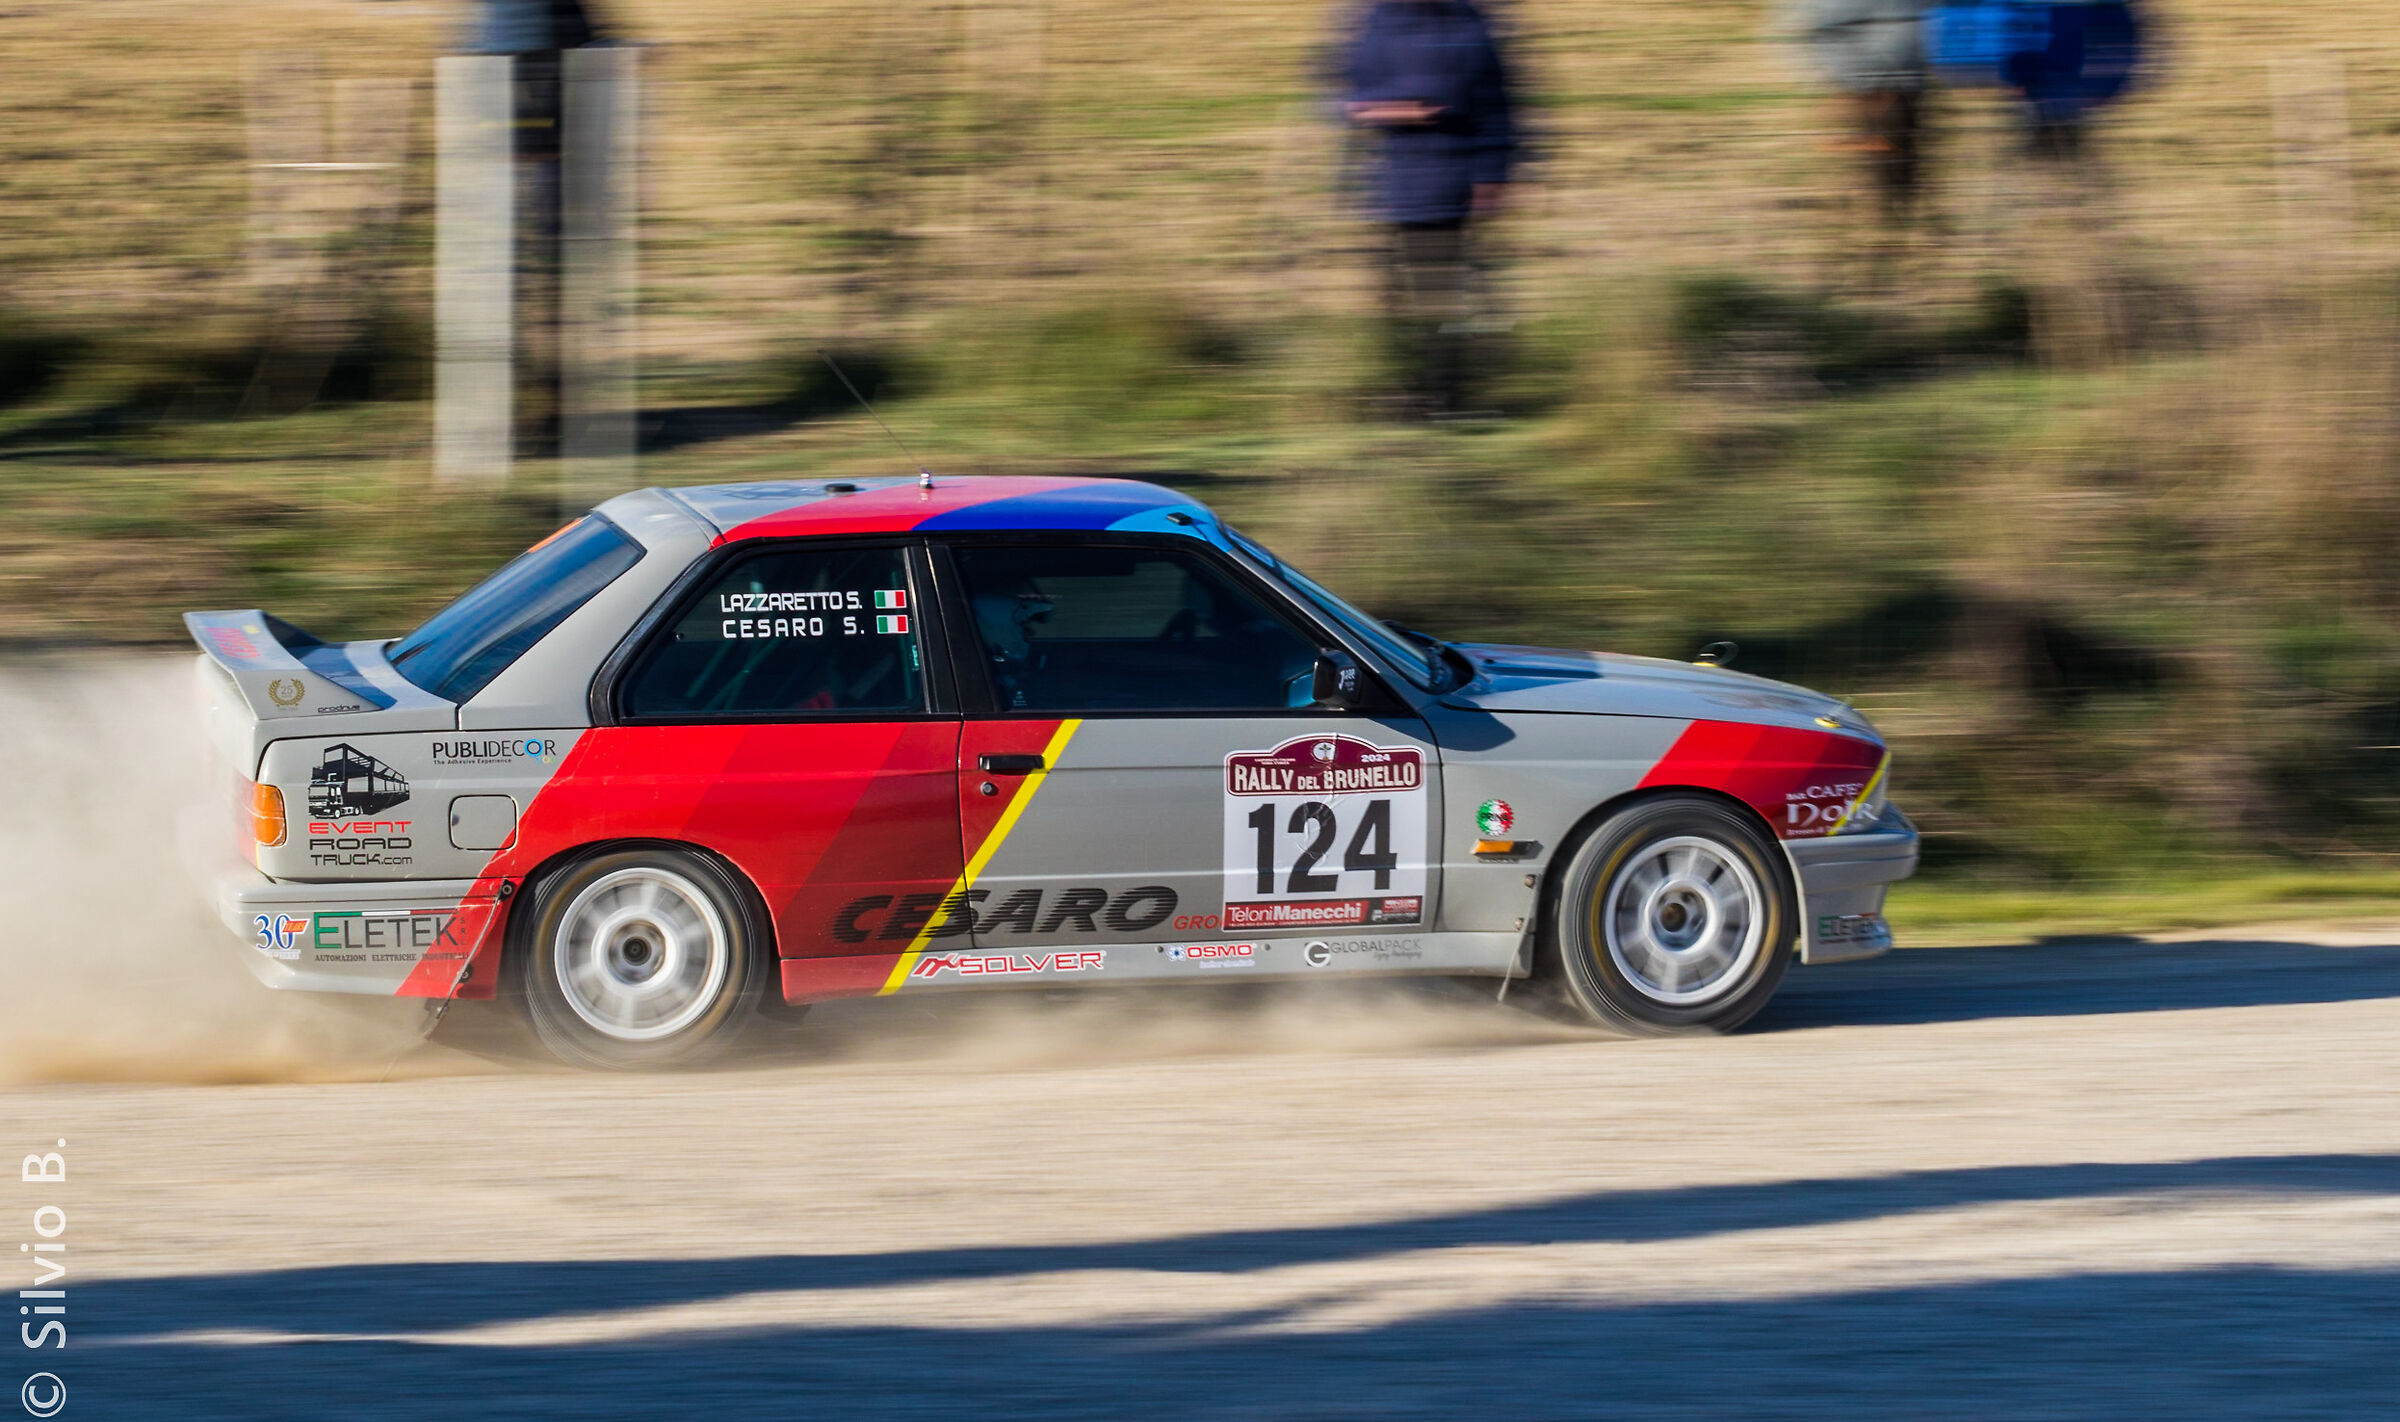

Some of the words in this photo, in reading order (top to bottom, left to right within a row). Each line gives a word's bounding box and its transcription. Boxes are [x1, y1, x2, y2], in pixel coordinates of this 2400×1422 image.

[720, 591, 843, 612] LAZZARETTO
[847, 590, 863, 610] S.
[722, 617, 824, 639] CESARO
[843, 616, 865, 635] S.
[432, 738, 556, 759] PUBLIDECOR
[1361, 753, 1391, 763] 2024
[1234, 763, 1295, 792] RALLY
[1297, 775, 1321, 791] DEL
[1323, 761, 1417, 790] BRUNELLO
[309, 820, 412, 835] EVENT
[309, 837, 412, 850] ROAD
[1248, 799, 1398, 895] 124
[310, 853, 413, 866] TRUCK.com
[831, 885, 1179, 943] CESARO
[314, 911, 461, 950] ELETEK
[315, 954, 367, 962] AUTOMAZIONI
[371, 953, 417, 962] ELETTRICHE
[1186, 944, 1253, 958] OSMO
[959, 951, 1103, 975] SOLVER
